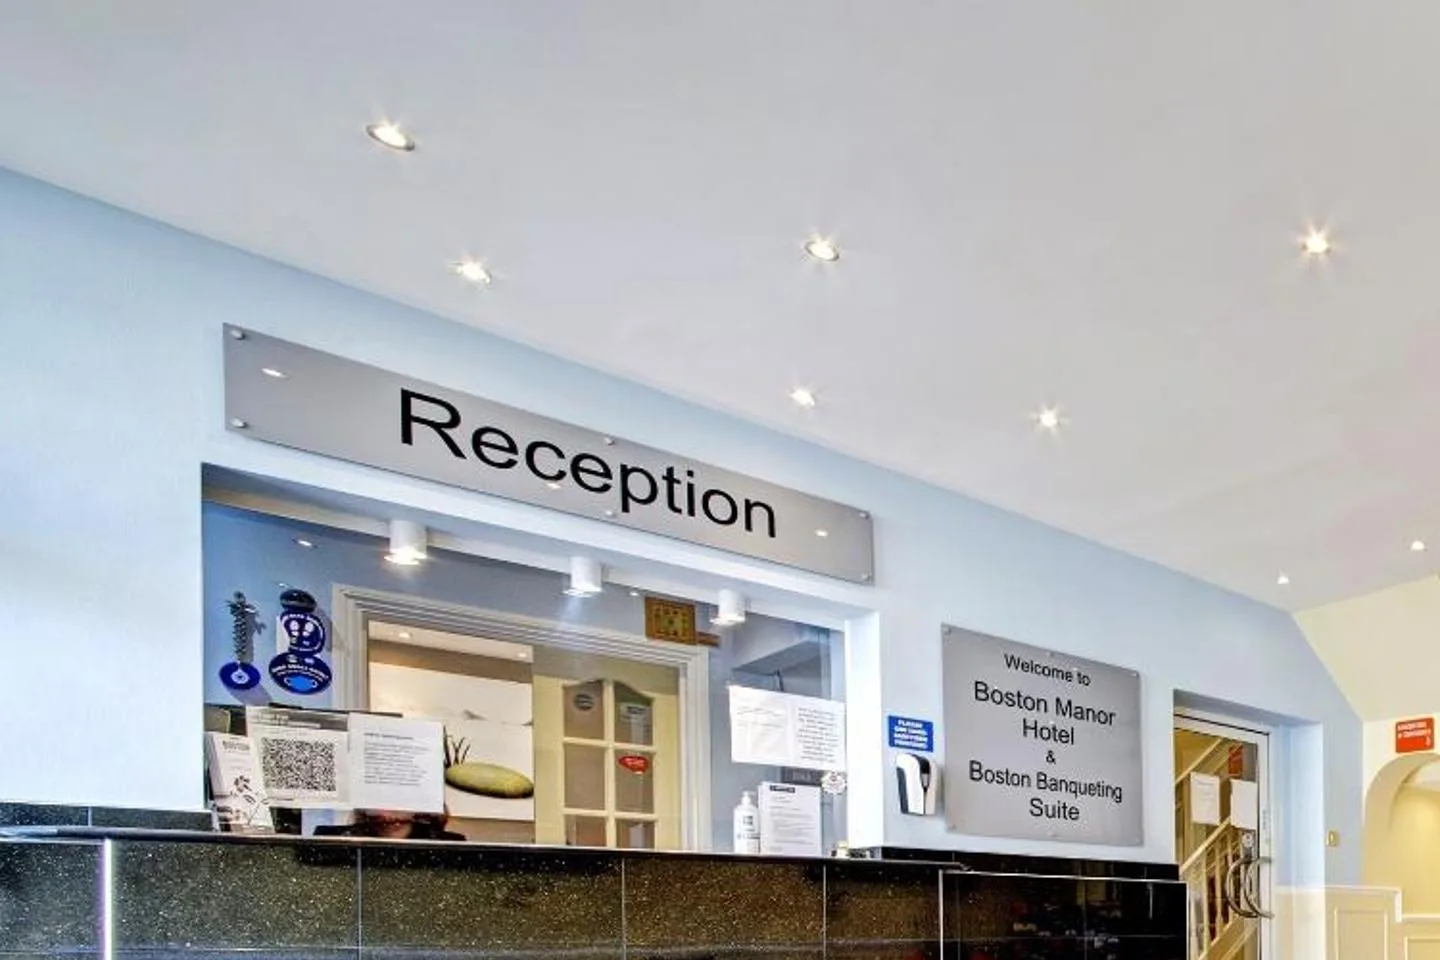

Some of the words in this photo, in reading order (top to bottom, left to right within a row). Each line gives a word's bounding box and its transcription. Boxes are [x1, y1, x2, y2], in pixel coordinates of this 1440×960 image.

[400, 387, 777, 539] Reception
[1003, 653, 1074, 683] Welcome
[1076, 670, 1092, 687] to
[973, 680, 1049, 714] Boston
[1055, 696, 1117, 727] Manor
[1022, 717, 1076, 746] Hotel
[1045, 749, 1057, 765] &
[968, 759, 1033, 789] Boston
[1036, 771, 1123, 804] Banqueting
[1029, 797, 1081, 821] Suite
